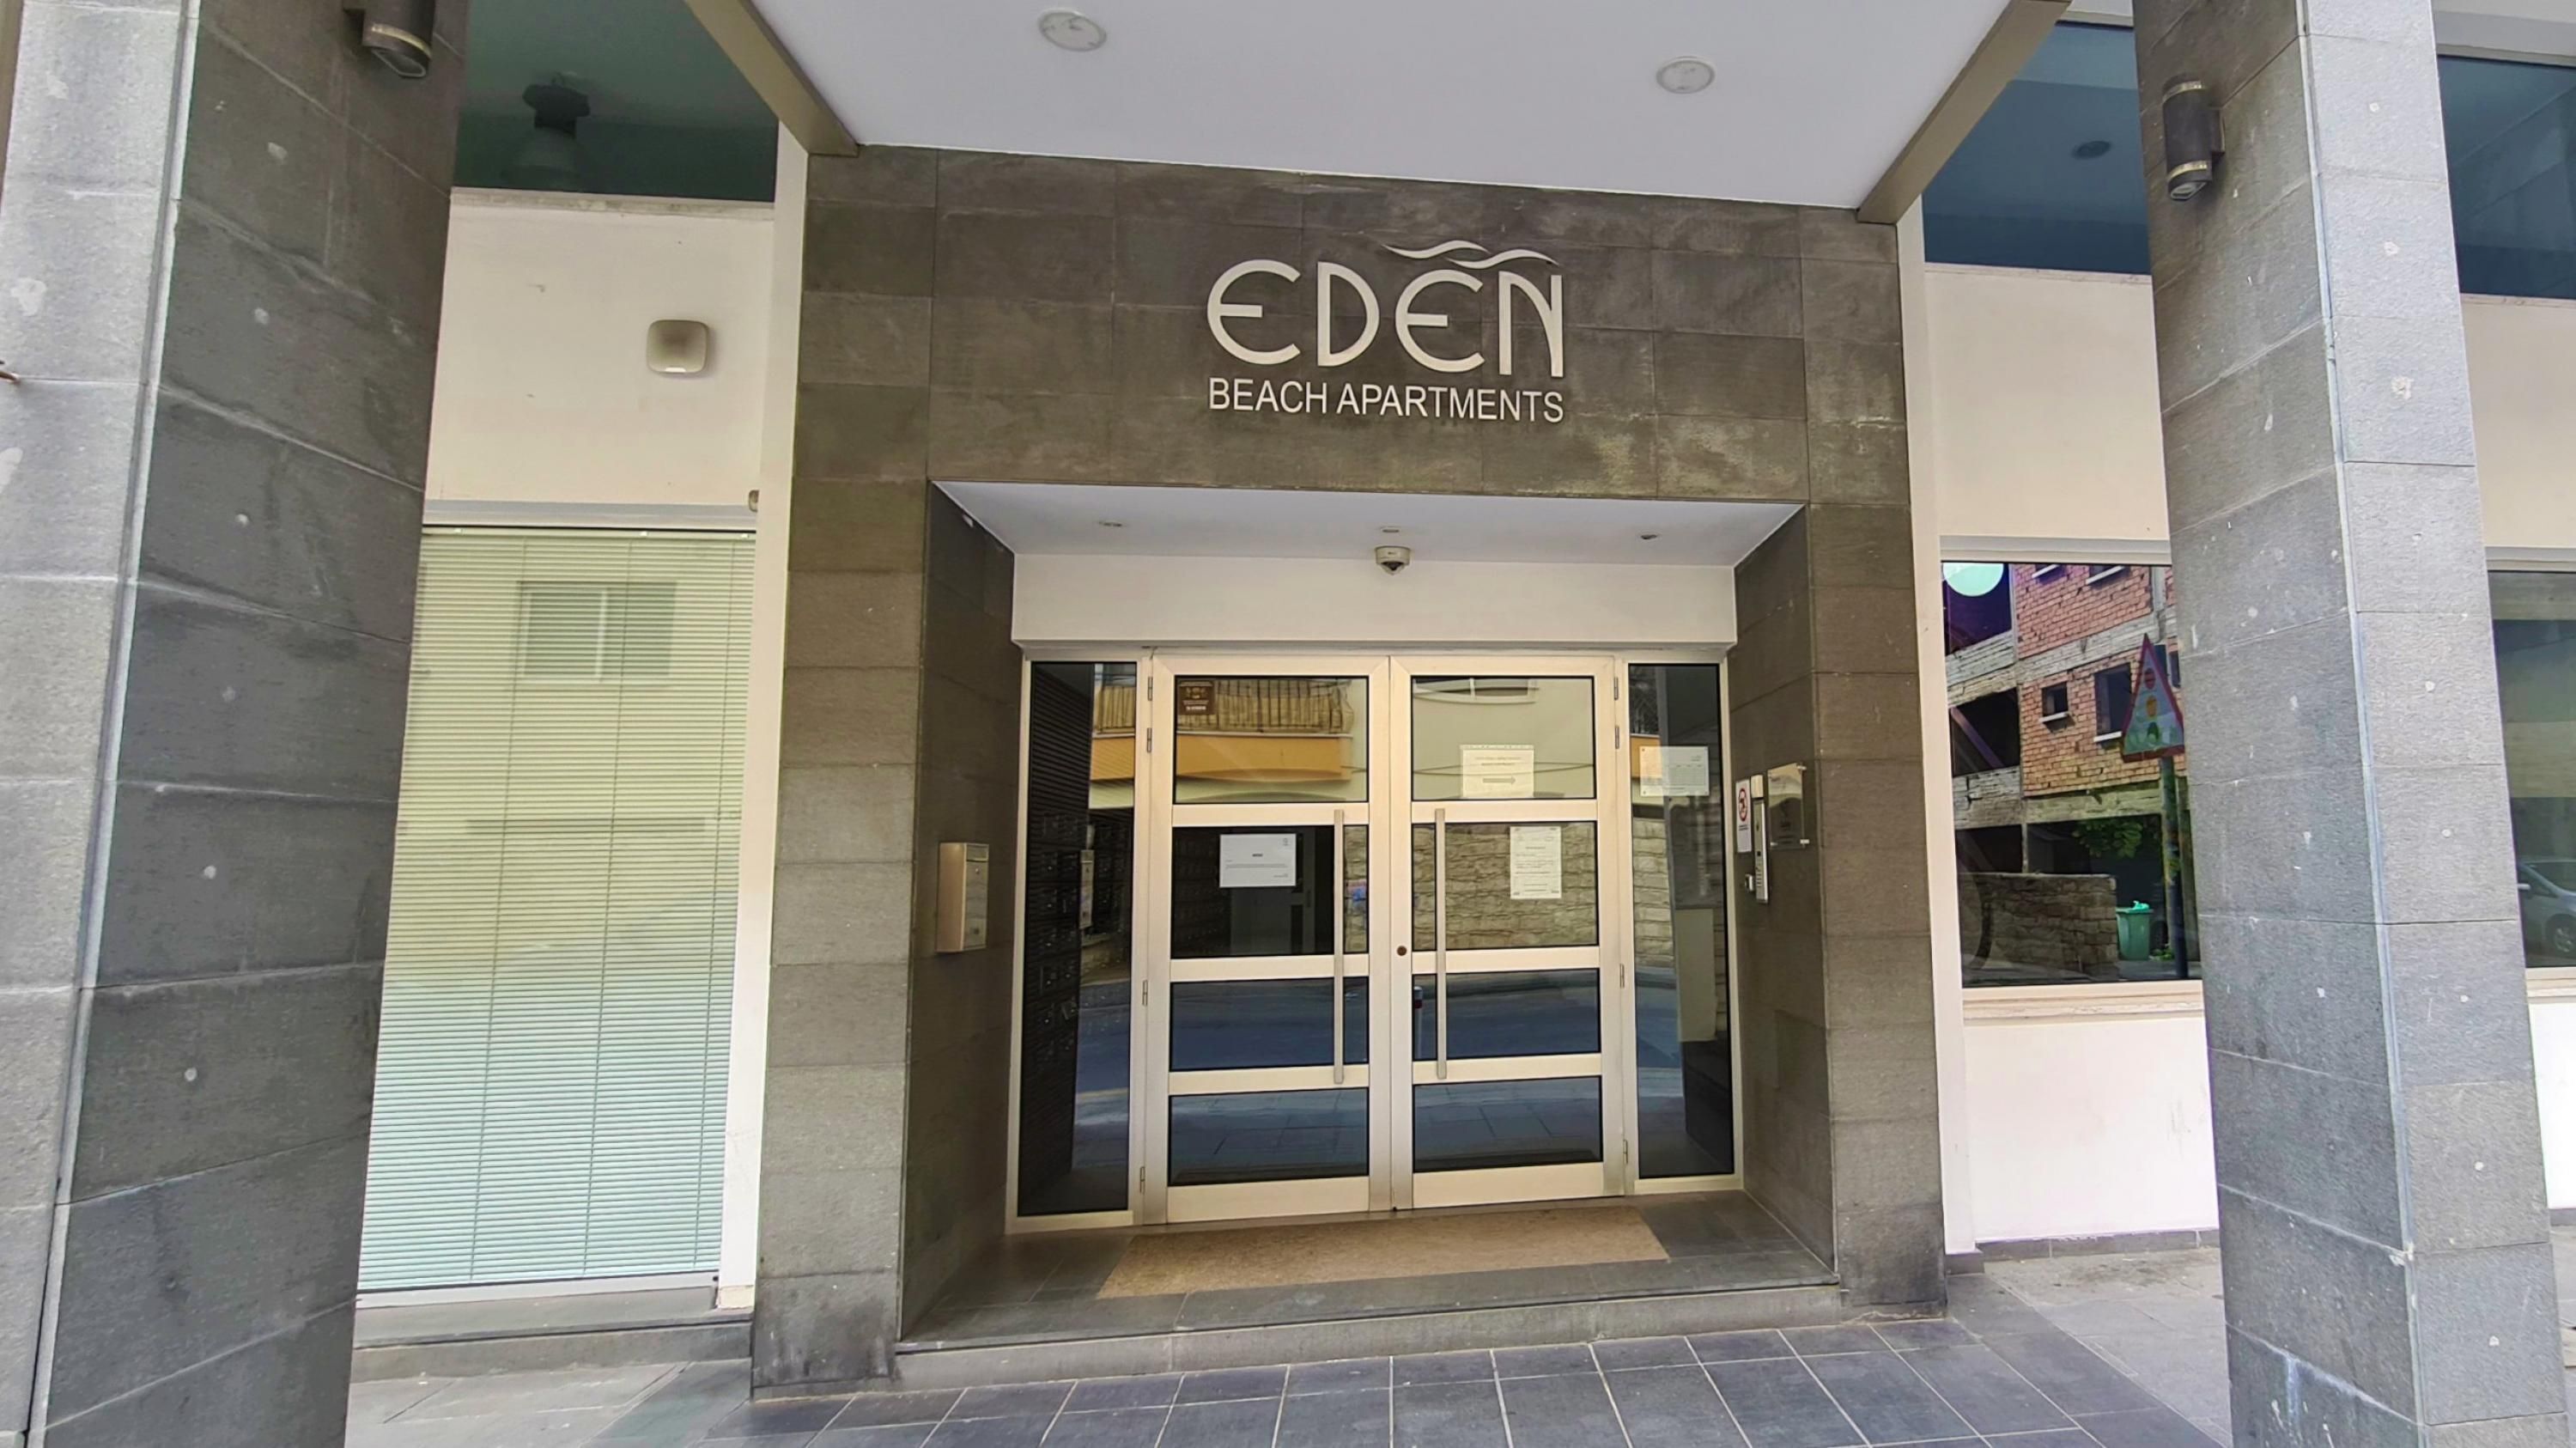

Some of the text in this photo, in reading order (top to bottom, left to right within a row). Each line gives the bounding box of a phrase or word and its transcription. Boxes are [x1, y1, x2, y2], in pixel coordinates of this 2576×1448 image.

[1206, 259, 1564, 378] EDEN
[1208, 377, 1564, 423] BEACH APARTMENTS
